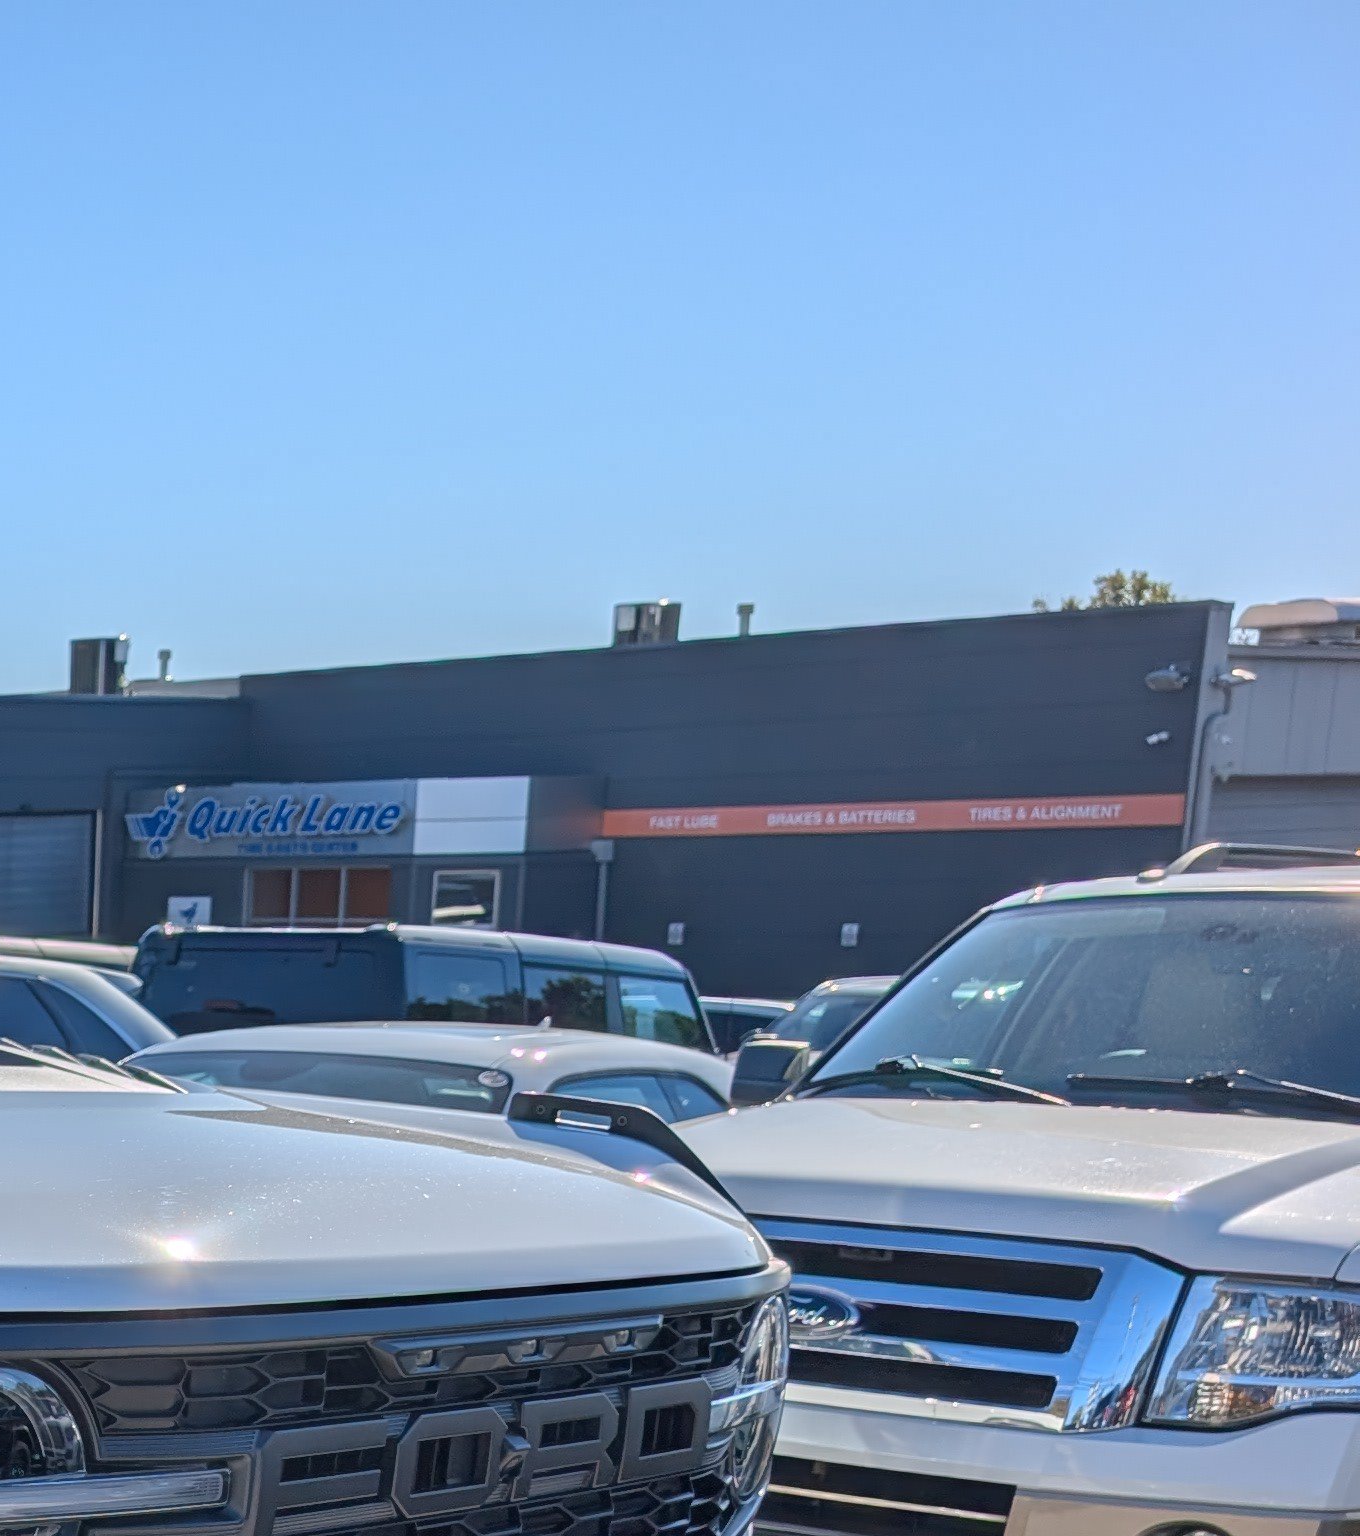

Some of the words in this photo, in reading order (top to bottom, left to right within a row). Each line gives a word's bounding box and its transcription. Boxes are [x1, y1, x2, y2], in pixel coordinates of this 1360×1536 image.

[649, 815, 680, 830] FAST
[683, 814, 718, 829] LUBE
[766, 811, 822, 827] BRAKES
[825, 811, 835, 824] &
[838, 808, 916, 824] BATTERIES
[969, 807, 1012, 822] TIRES
[1015, 806, 1027, 821] &
[1030, 803, 1123, 821] ALIGNMENT
